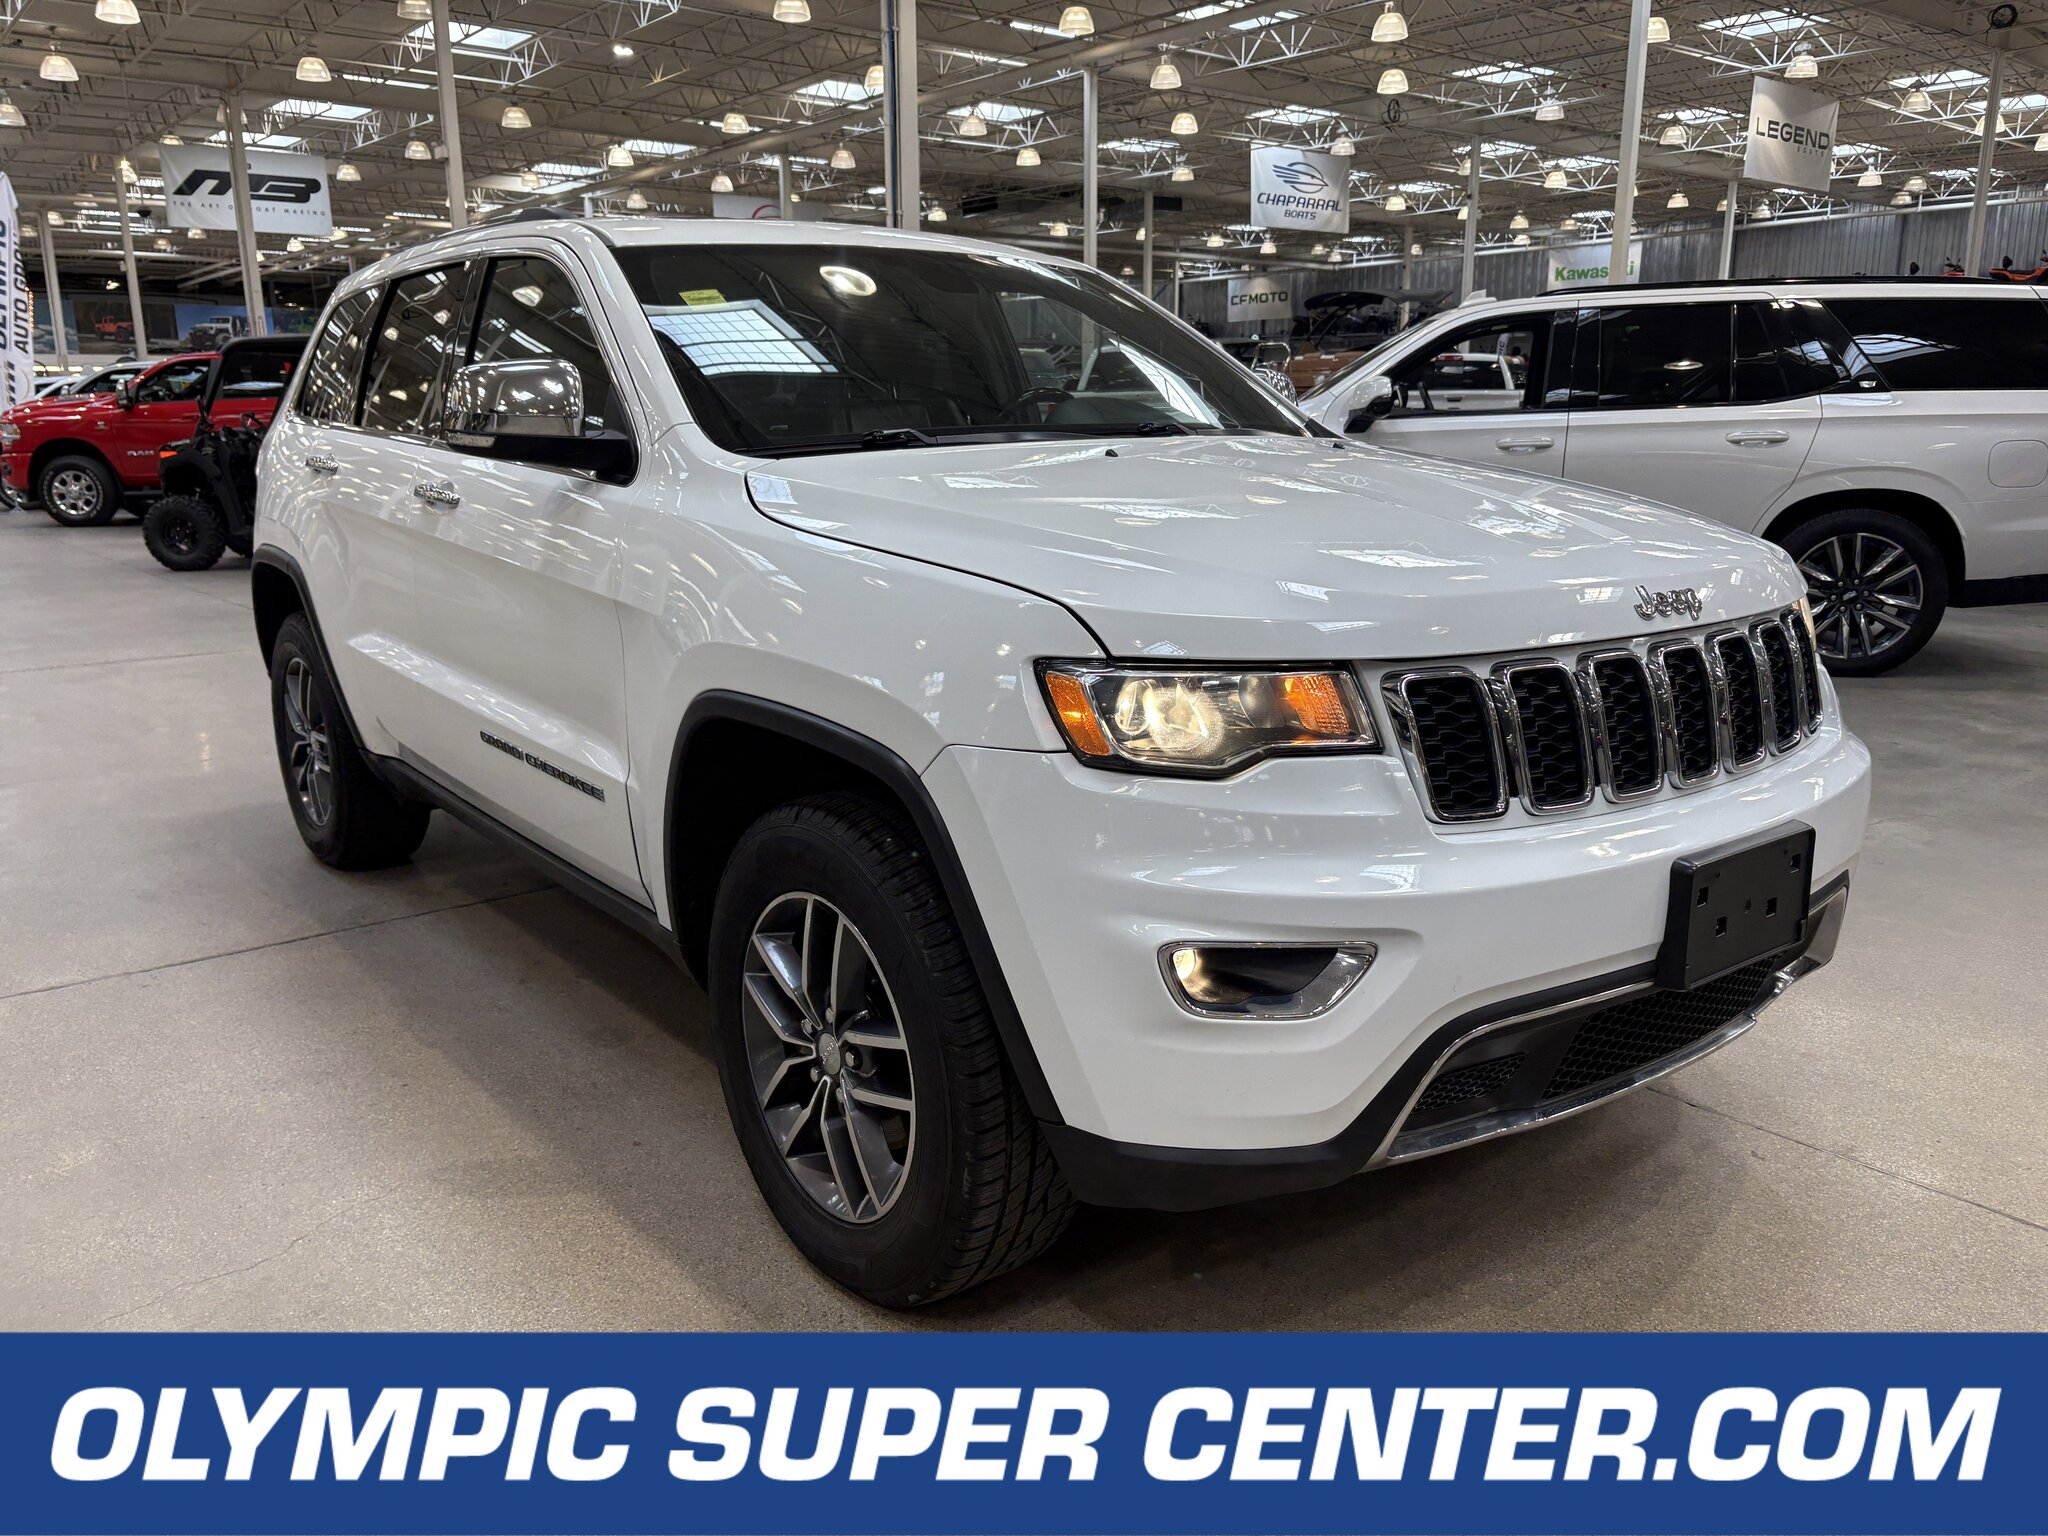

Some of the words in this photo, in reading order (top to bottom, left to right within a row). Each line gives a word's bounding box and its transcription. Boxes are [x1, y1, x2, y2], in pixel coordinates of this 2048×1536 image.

[1755, 116, 1830, 150] LEGEND
[284, 208, 326, 216] MAKING
[1257, 192, 1342, 212] CHAPARRAL
[1284, 209, 1317, 221] BOATS
[1554, 260, 1635, 282] Kawasi
[1230, 291, 1288, 306] CFMOTO
[13, 298, 29, 354] AUTO
[1633, 584, 1703, 621] Jeep
[479, 730, 525, 761] GRAND
[524, 752, 606, 803] CHEROKEE
